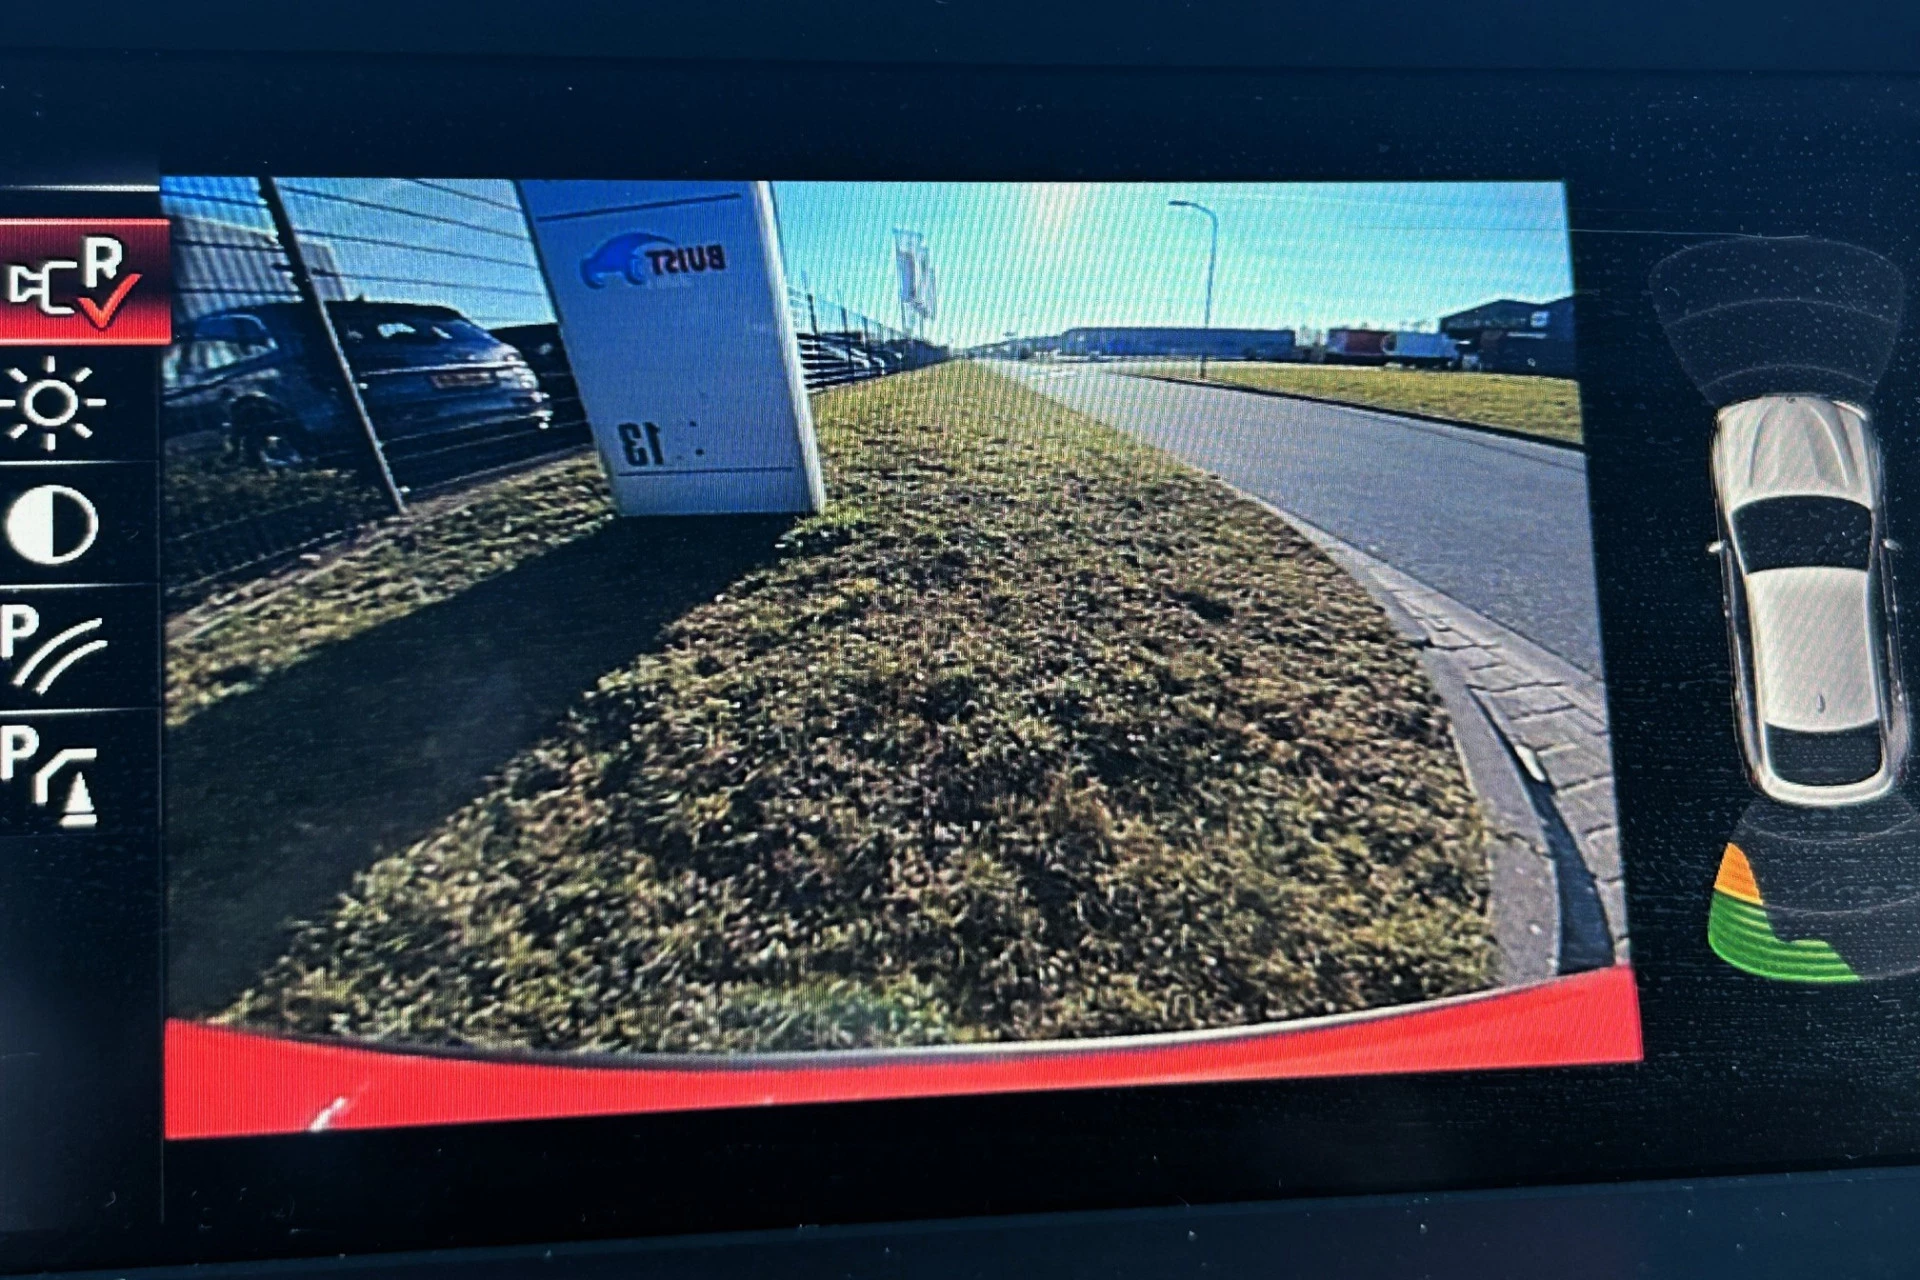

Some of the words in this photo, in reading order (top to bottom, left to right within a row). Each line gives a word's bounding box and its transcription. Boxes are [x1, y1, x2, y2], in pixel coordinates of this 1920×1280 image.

[85, 236, 123, 288] R
[0, 604, 40, 659] P
[0, 724, 40, 781] P
